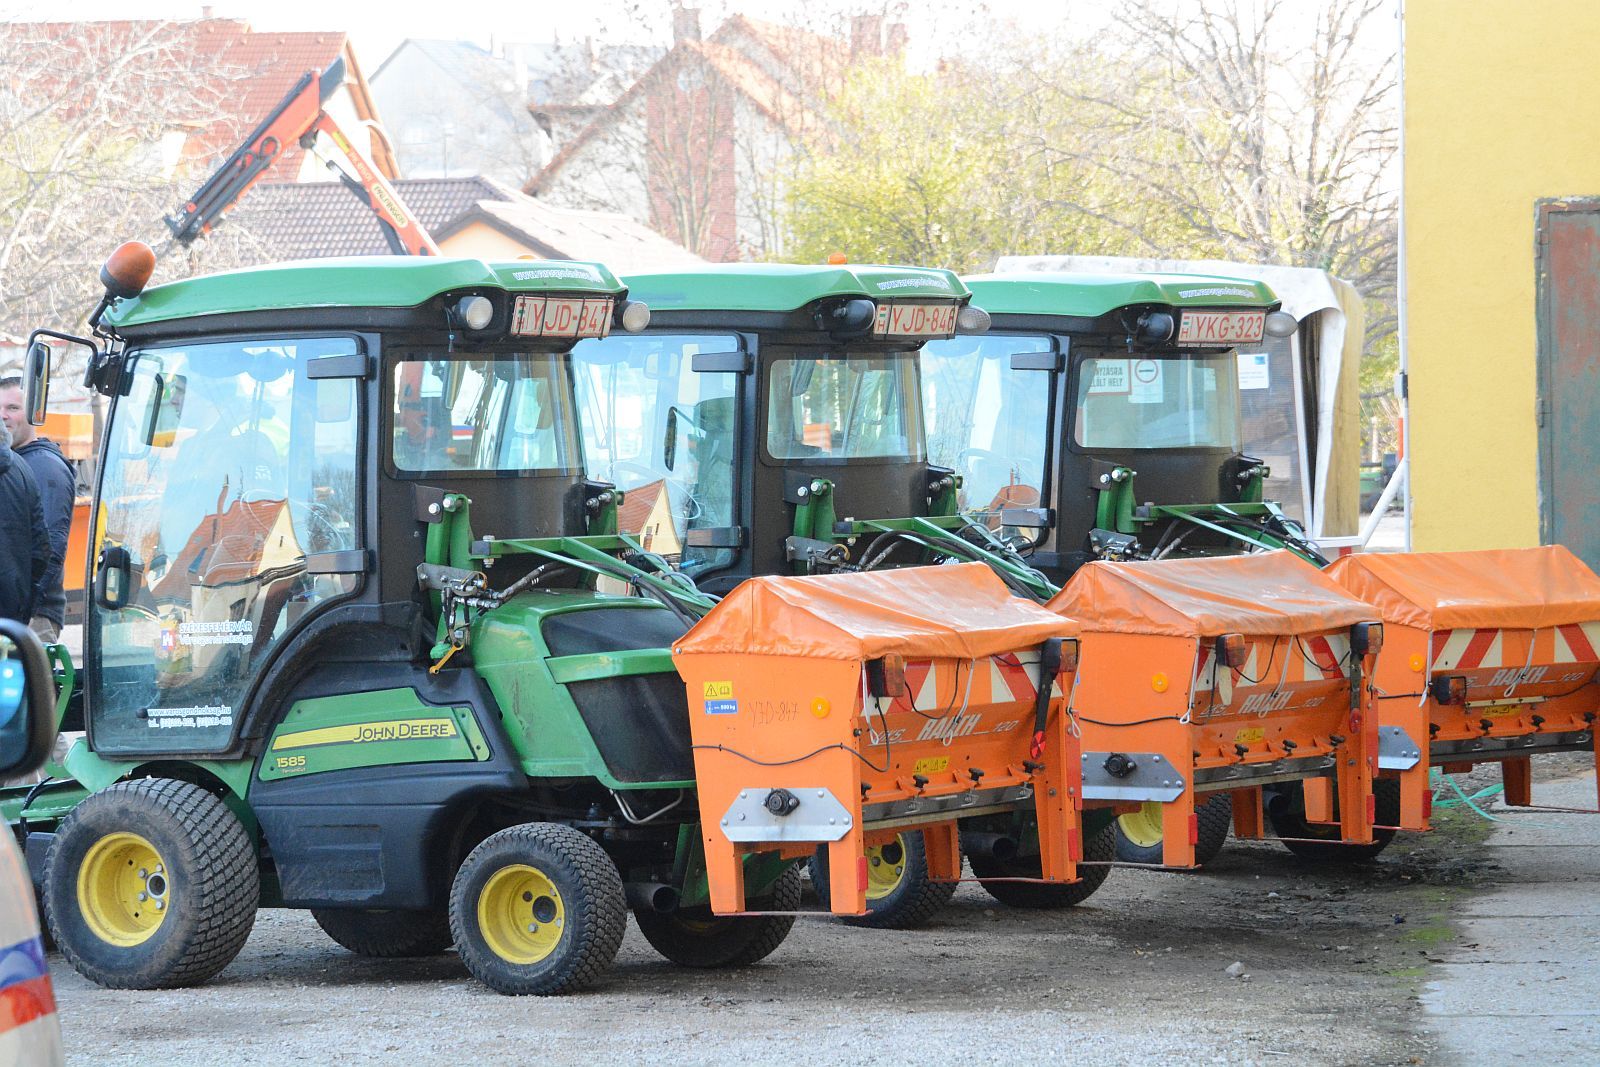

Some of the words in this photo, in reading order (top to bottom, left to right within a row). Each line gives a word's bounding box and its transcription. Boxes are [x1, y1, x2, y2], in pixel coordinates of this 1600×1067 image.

[533, 302, 611, 332] YJD-847
[877, 320, 885, 331] H
[892, 307, 955, 333] YJD-846
[1181, 327, 1189, 339] H
[1195, 315, 1263, 338] YKG-323
[179, 618, 253, 633] SZÉKESFEHÉRVÁR
[353, 726, 395, 741] JOHN
[399, 723, 449, 737] DEERE
[276, 755, 306, 768] 1585
